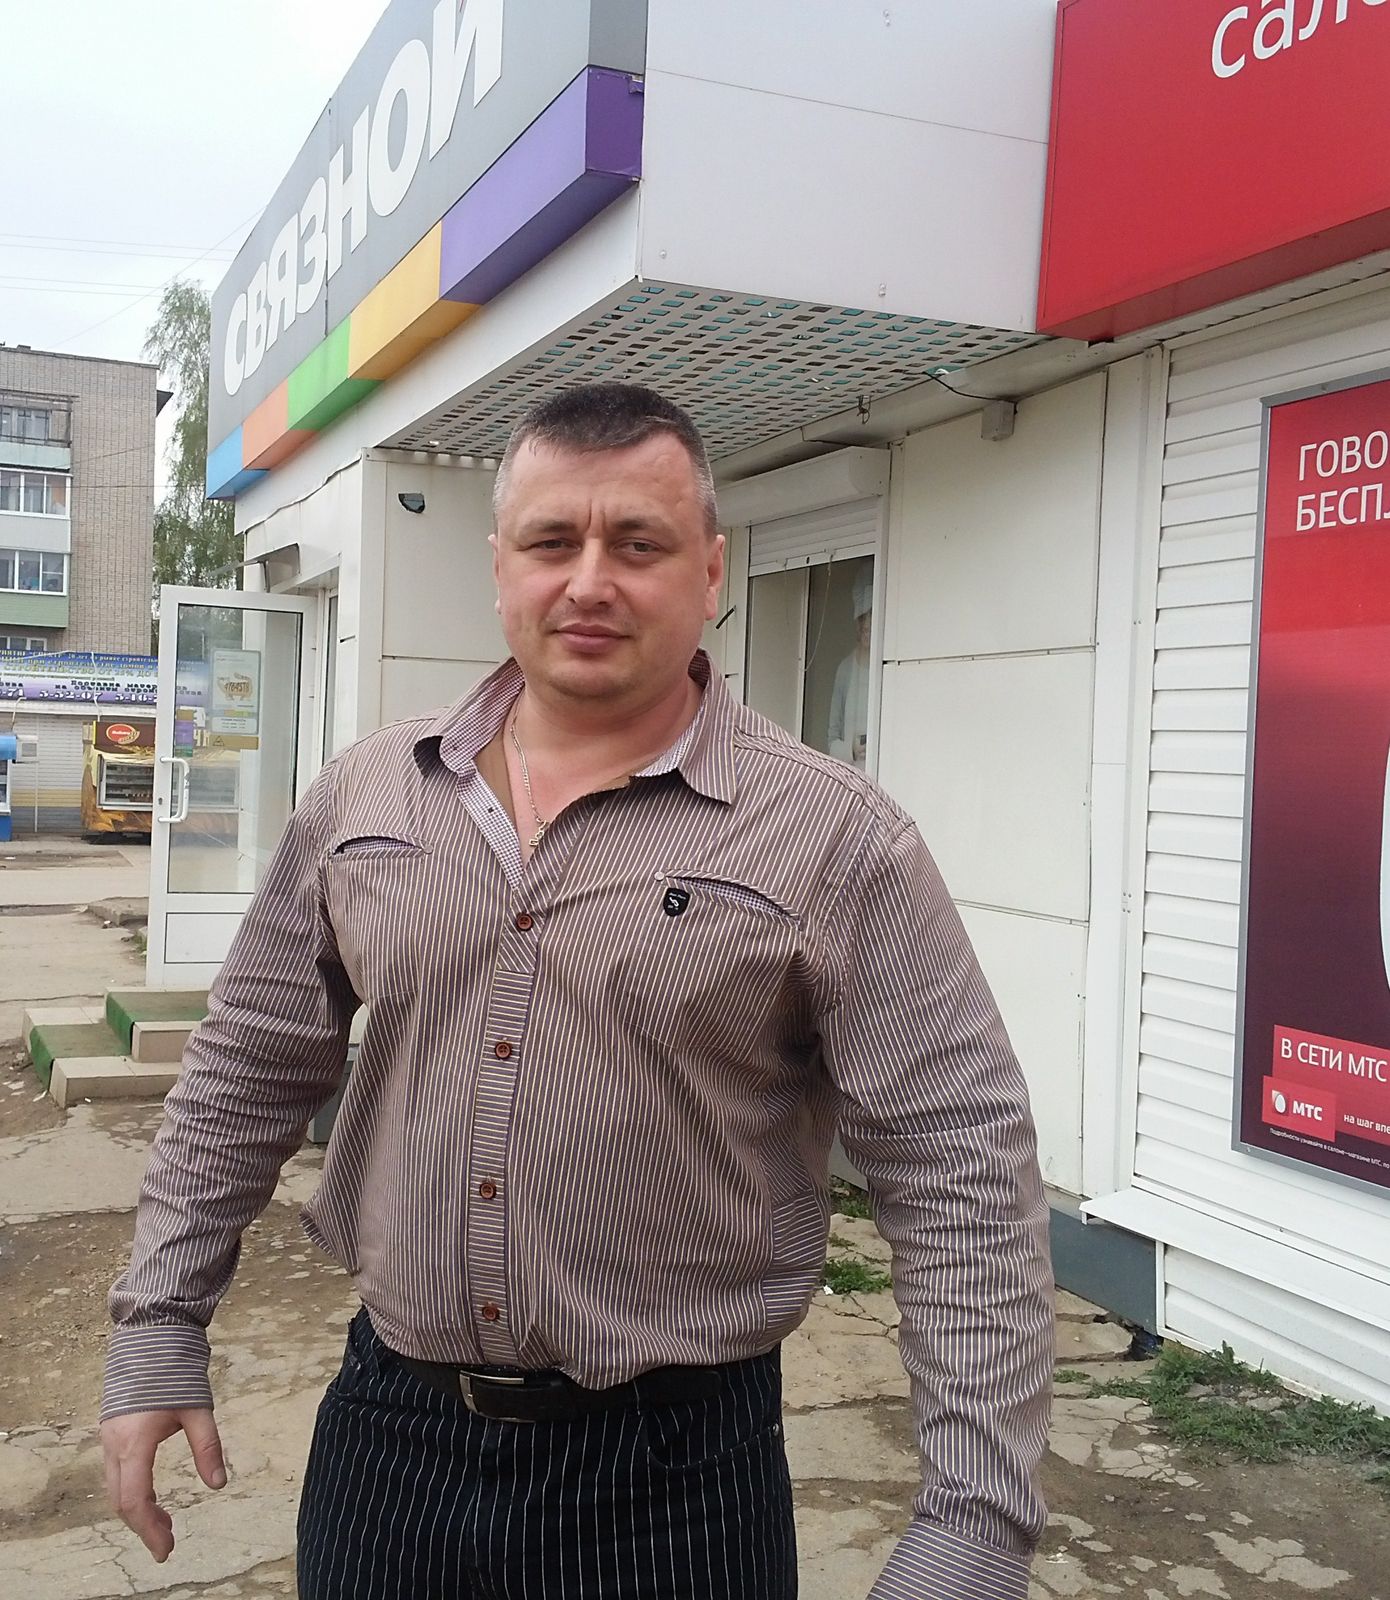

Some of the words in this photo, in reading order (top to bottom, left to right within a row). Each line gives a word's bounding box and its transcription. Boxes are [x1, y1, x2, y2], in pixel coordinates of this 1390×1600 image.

[39, 690, 103, 701] 5-52-07
[1281, 1037, 1292, 1059] В
[1297, 1042, 1342, 1072] СЕТИ
[1348, 1053, 1388, 1083] МТС
[1292, 1100, 1323, 1121] МТС
[1343, 1114, 1355, 1125] на
[1356, 1117, 1374, 1129] шаг
